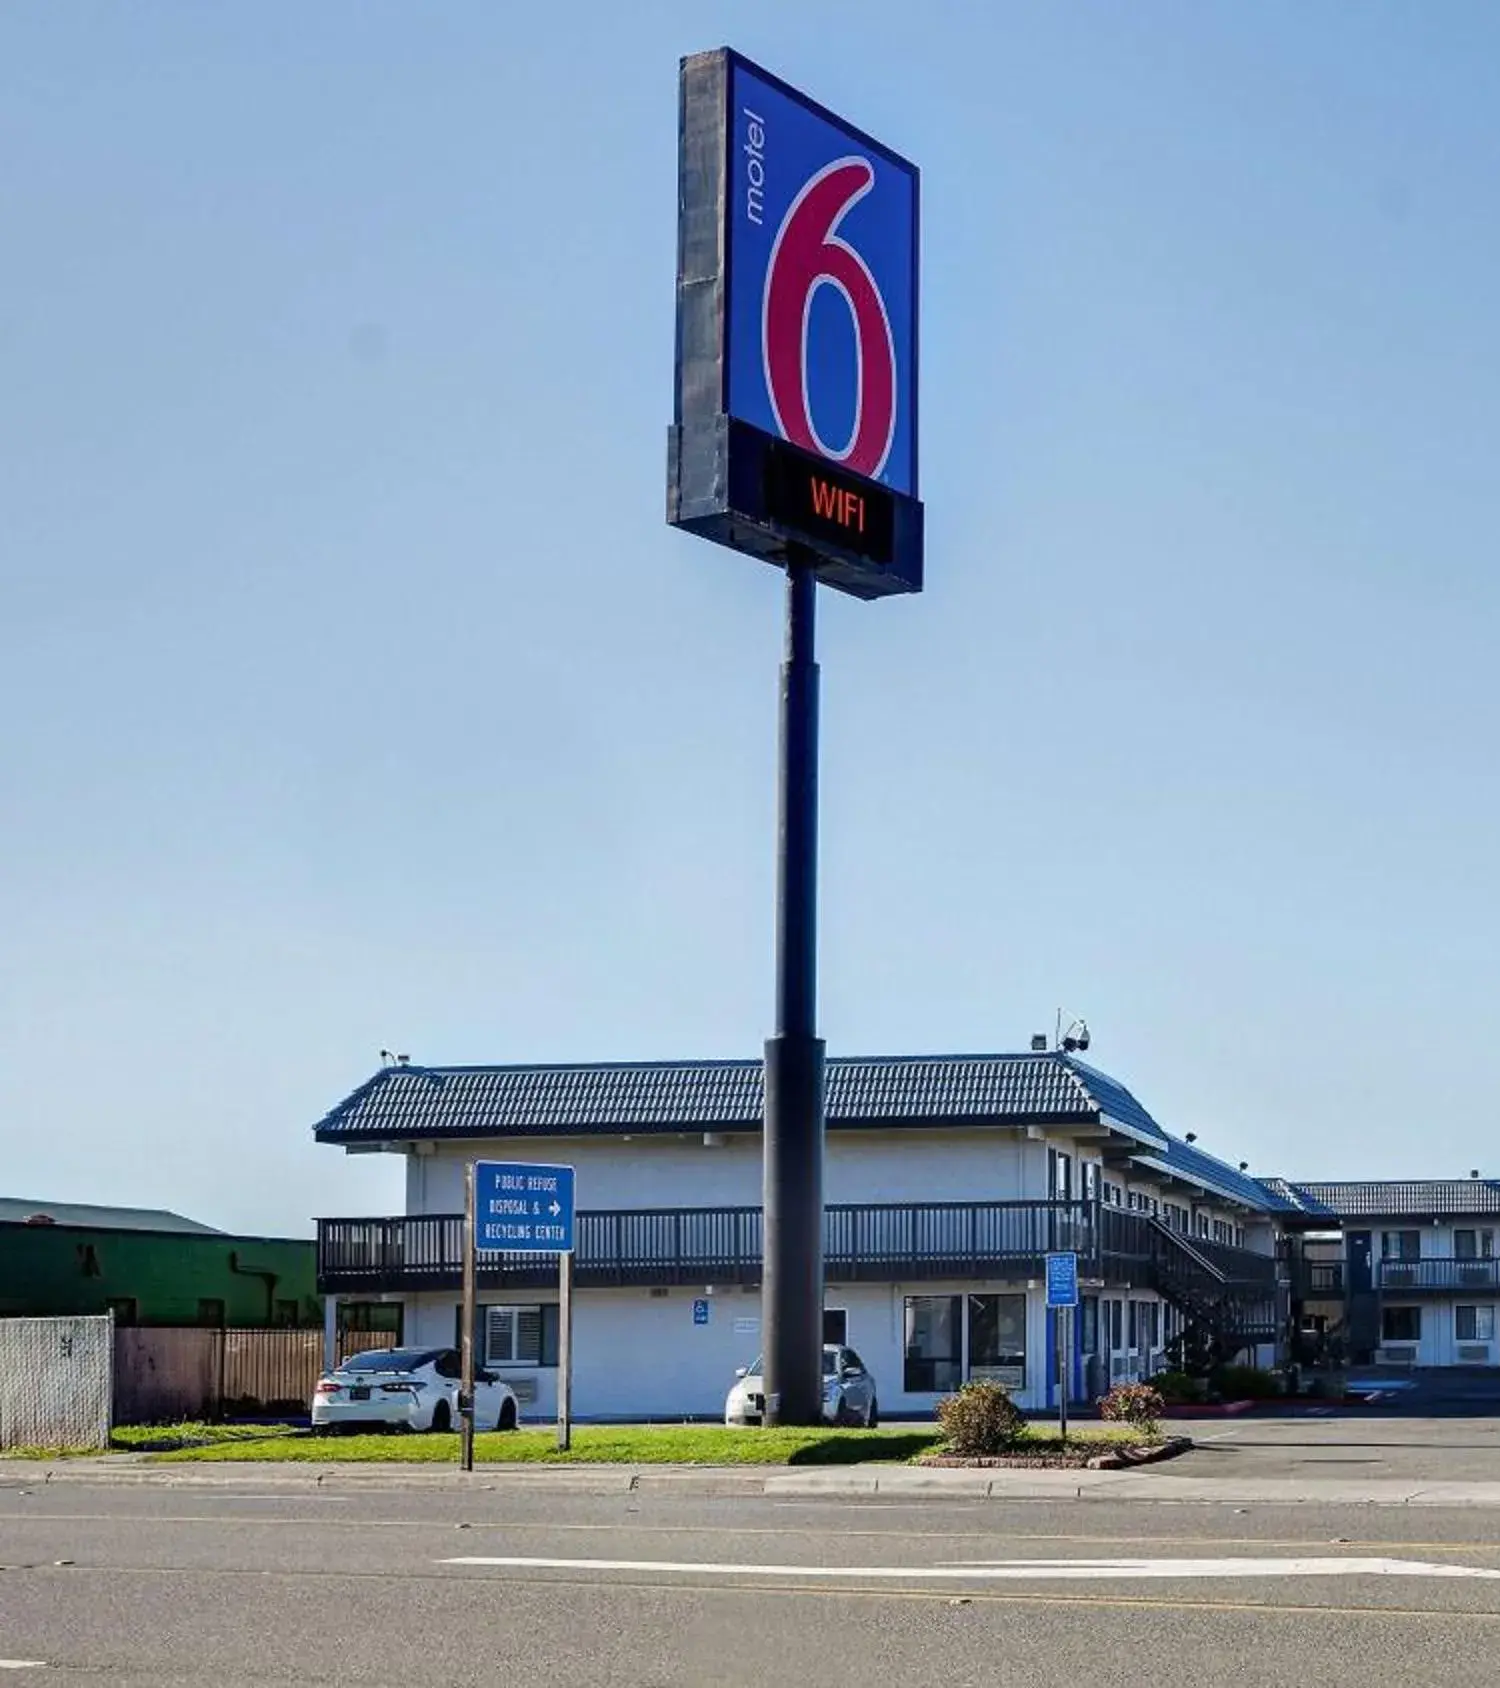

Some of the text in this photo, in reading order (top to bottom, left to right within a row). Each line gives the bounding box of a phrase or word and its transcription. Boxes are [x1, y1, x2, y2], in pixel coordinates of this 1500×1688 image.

[743, 107, 765, 225] motel
[762, 155, 897, 480] 6
[811, 475, 864, 534] WIFI
[495, 1174, 557, 1192] PUBLIC REFUSE
[489, 1199, 528, 1215] DISPOSAL
[485, 1223, 565, 1241] RECYCLING CENTER
